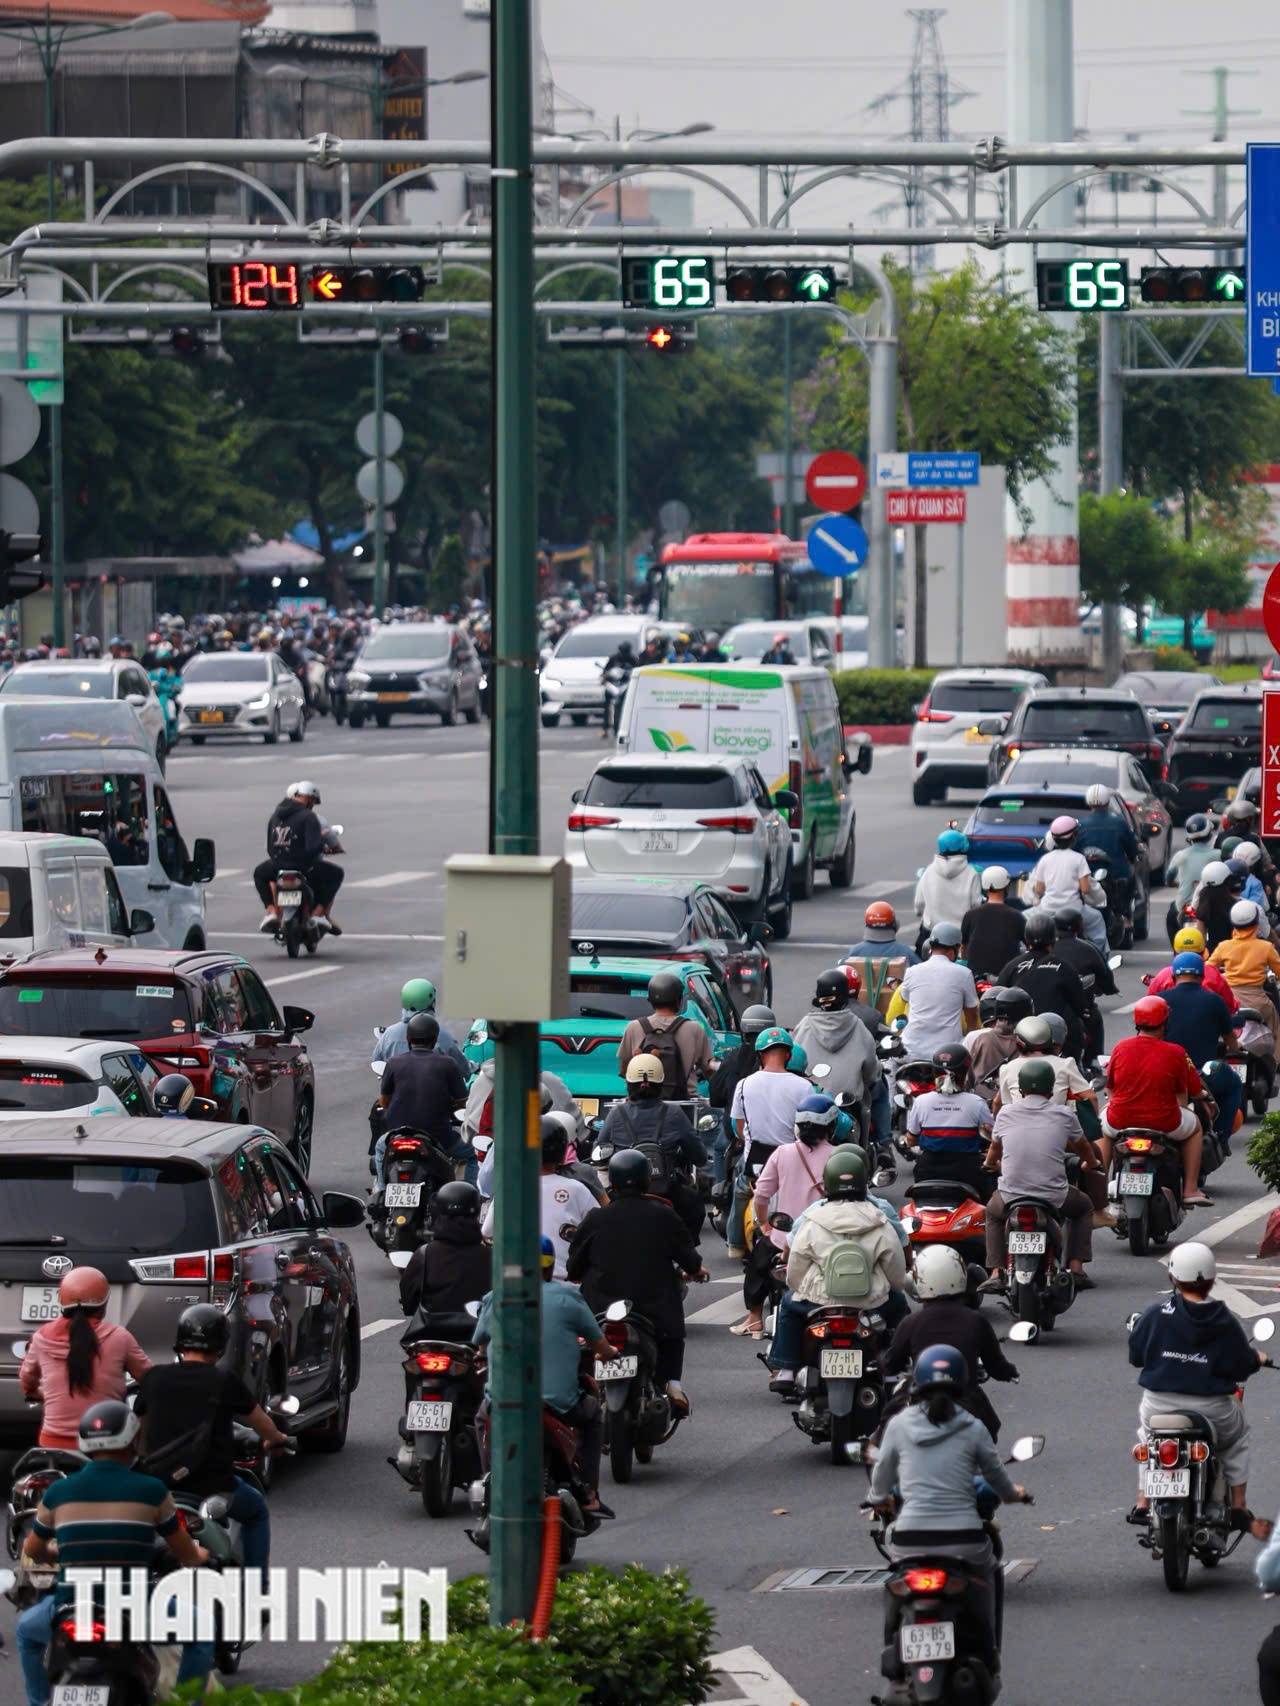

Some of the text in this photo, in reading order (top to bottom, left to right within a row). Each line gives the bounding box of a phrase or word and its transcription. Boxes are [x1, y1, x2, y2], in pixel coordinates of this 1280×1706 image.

[232, 263, 297, 306] 124
[655, 259, 710, 305] 65
[1069, 262, 1124, 307] 65
[890, 495, 908, 516] CHÚ
[918, 499, 944, 516] QUAN
[945, 495, 965, 516] SÁT
[392, 1186, 416, 1195] 50-AC
[389, 1196, 417, 1205] 874.94
[1015, 1233, 1041, 1243] 59-P3
[1011, 1243, 1043, 1252] 095.78
[828, 1352, 855, 1363] 77-H1
[825, 1366, 859, 1376] 403.46
[416, 1402, 444, 1414] 76-G1
[410, 1416, 448, 1429] 459.40
[1153, 1472, 1183, 1483] 62-AU
[1149, 1484, 1186, 1495] 007.94
[910, 1626, 946, 1643] 63-B5
[906, 1642, 951, 1659] 573.79
[63, 1687, 100, 1701] 60-H5
